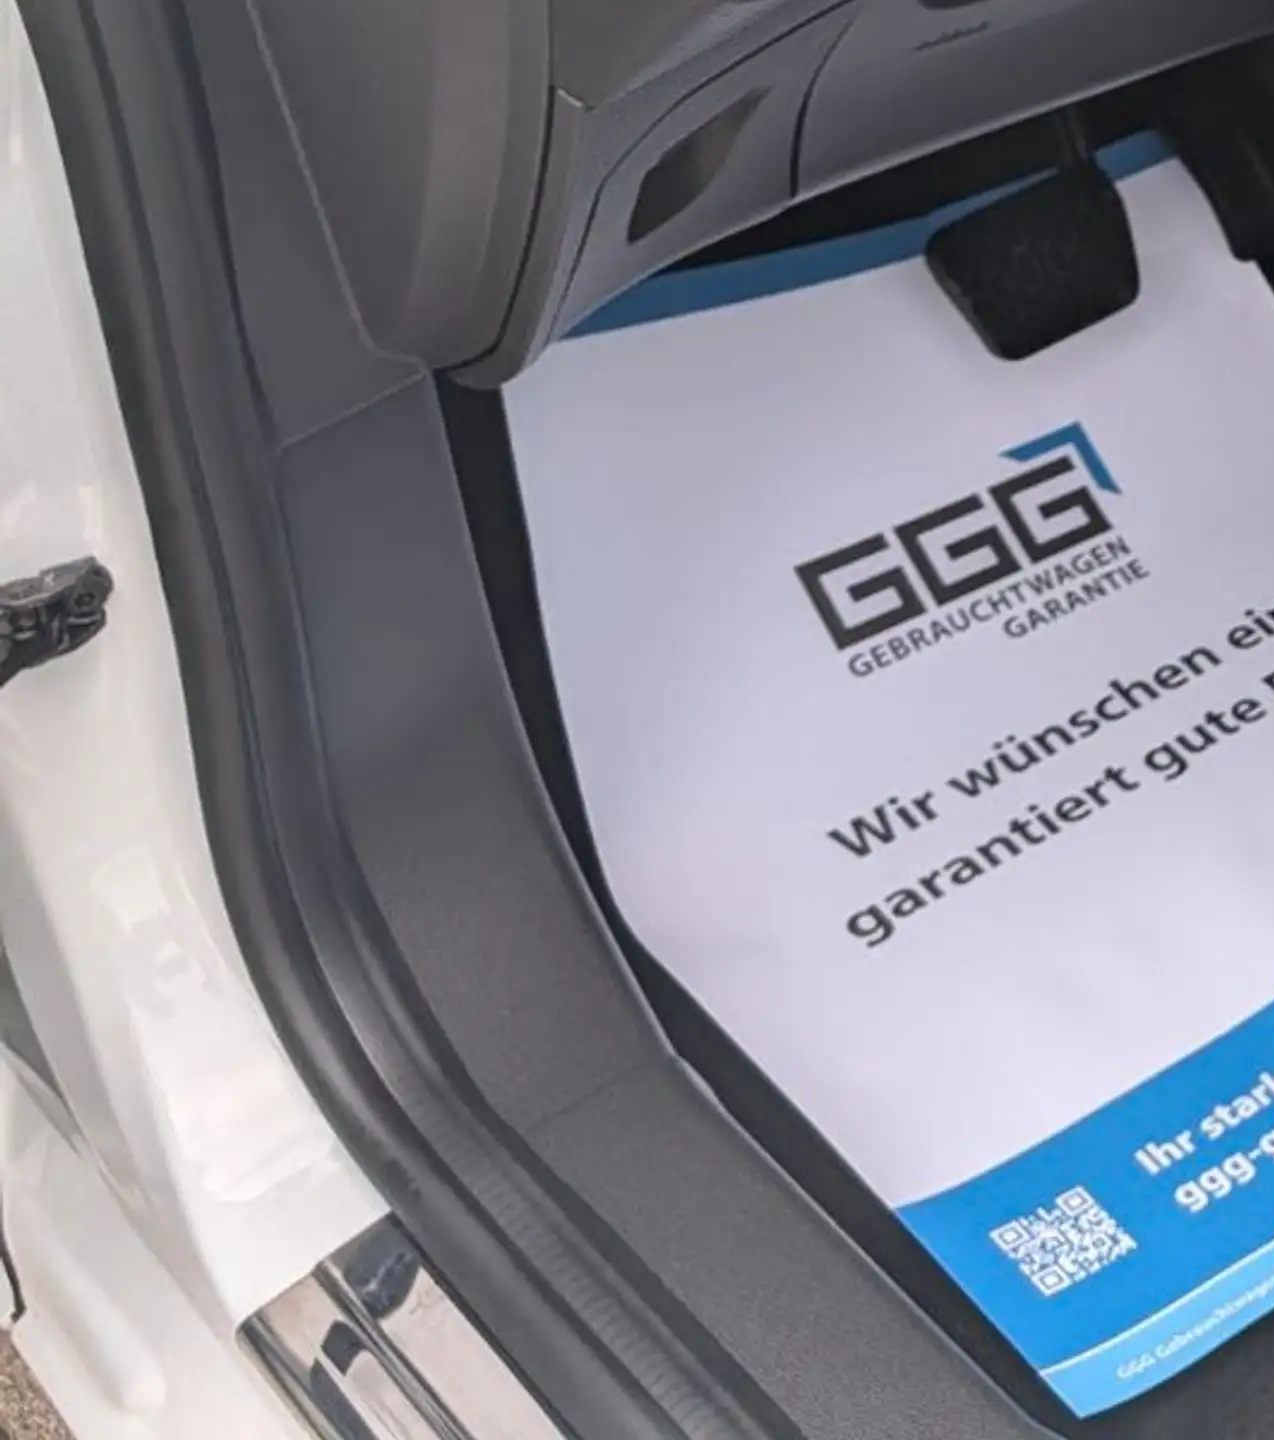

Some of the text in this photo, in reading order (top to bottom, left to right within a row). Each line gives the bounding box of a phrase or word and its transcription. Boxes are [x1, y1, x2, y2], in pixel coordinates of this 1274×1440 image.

[794, 455, 1112, 651] GGG
[847, 535, 1132, 678] GEBRAUCHTWAGEN
[1002, 558, 1151, 639] GARANTIE
[827, 787, 937, 860] Wir
[948, 642, 1222, 798] wünschen
[846, 763, 1141, 948] garantiert
[1142, 695, 1268, 781] gute
[1134, 1130, 1195, 1174] Ihr
